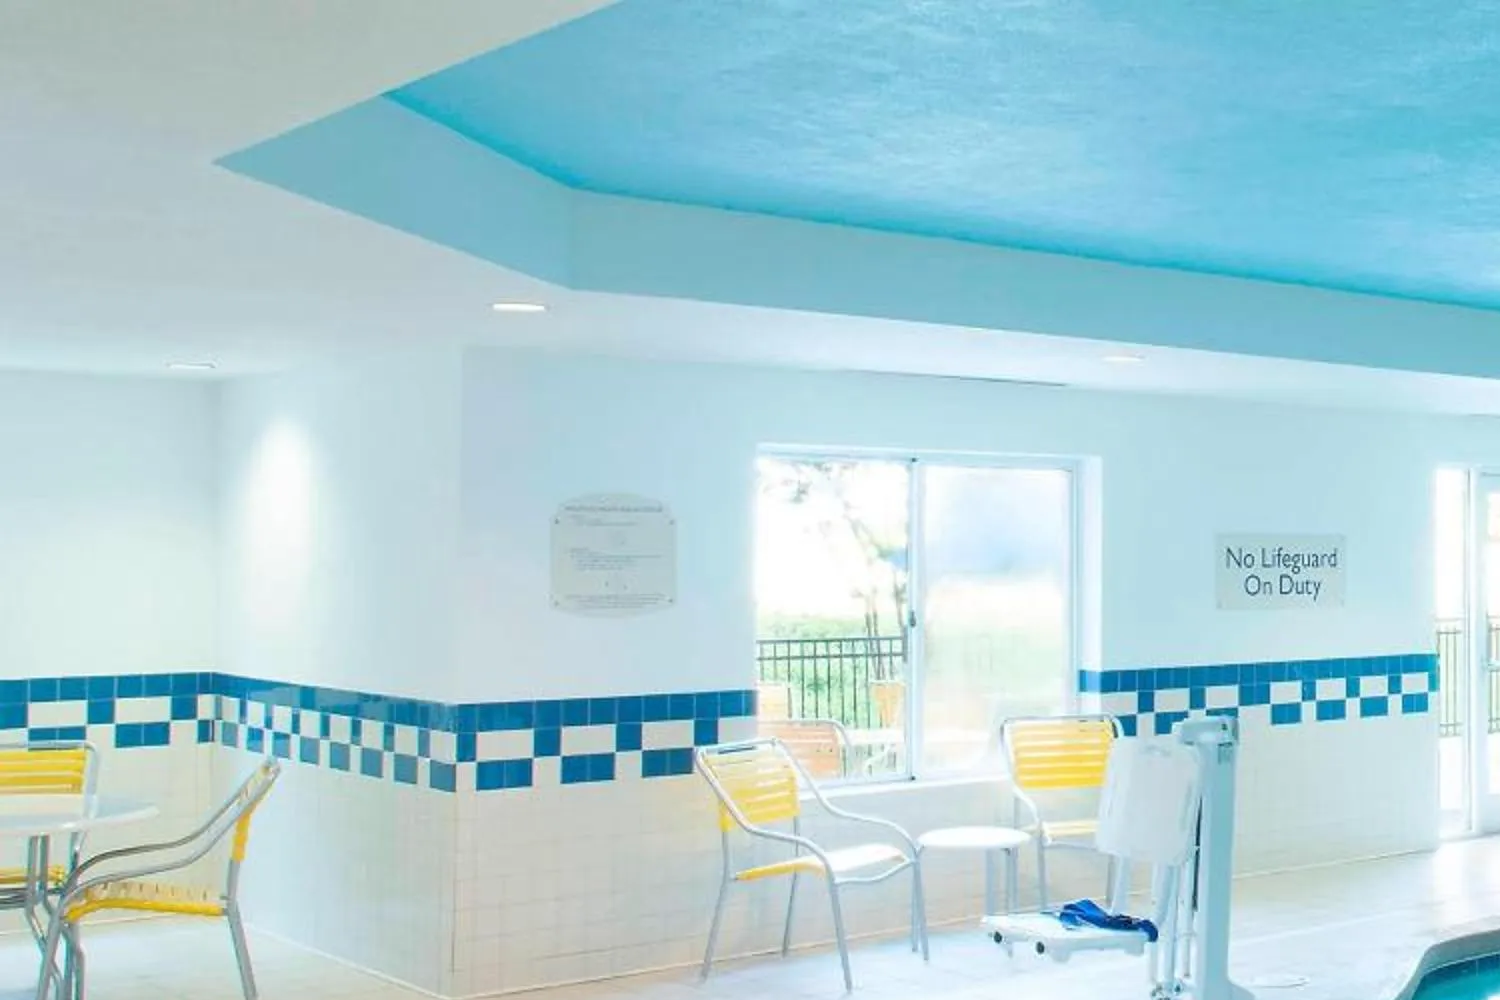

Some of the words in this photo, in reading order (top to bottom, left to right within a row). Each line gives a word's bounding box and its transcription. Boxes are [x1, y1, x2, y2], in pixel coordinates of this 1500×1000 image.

[1225, 547, 1255, 569] No
[1261, 547, 1338, 575] Lifeguard
[1244, 574, 1273, 596] On
[1279, 574, 1322, 602] Duty
